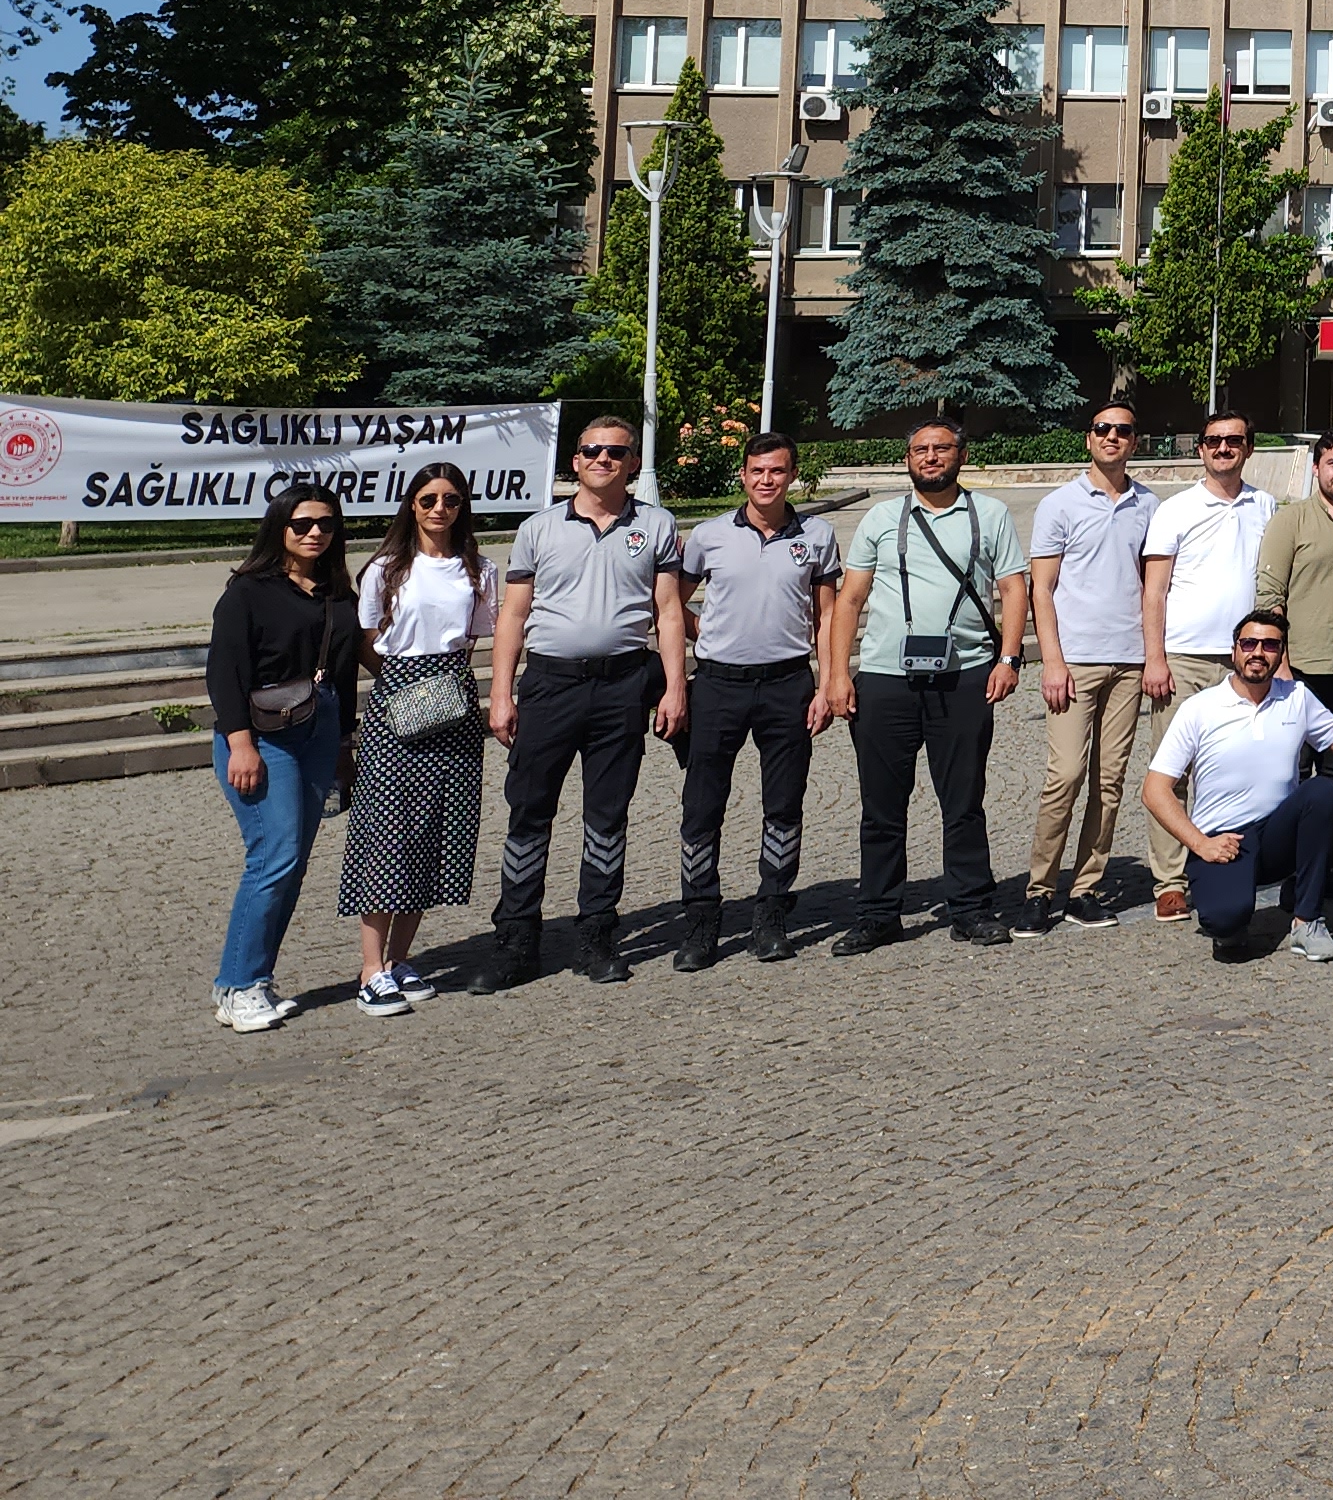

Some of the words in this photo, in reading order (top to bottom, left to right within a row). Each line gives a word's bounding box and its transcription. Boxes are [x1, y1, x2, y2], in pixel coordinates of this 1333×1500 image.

[181, 409, 341, 446] SAĞLIKLI
[351, 413, 467, 454] YAŞAM
[81, 462, 257, 508] SAĞLIKLI
[467, 469, 532, 501] LUR.
